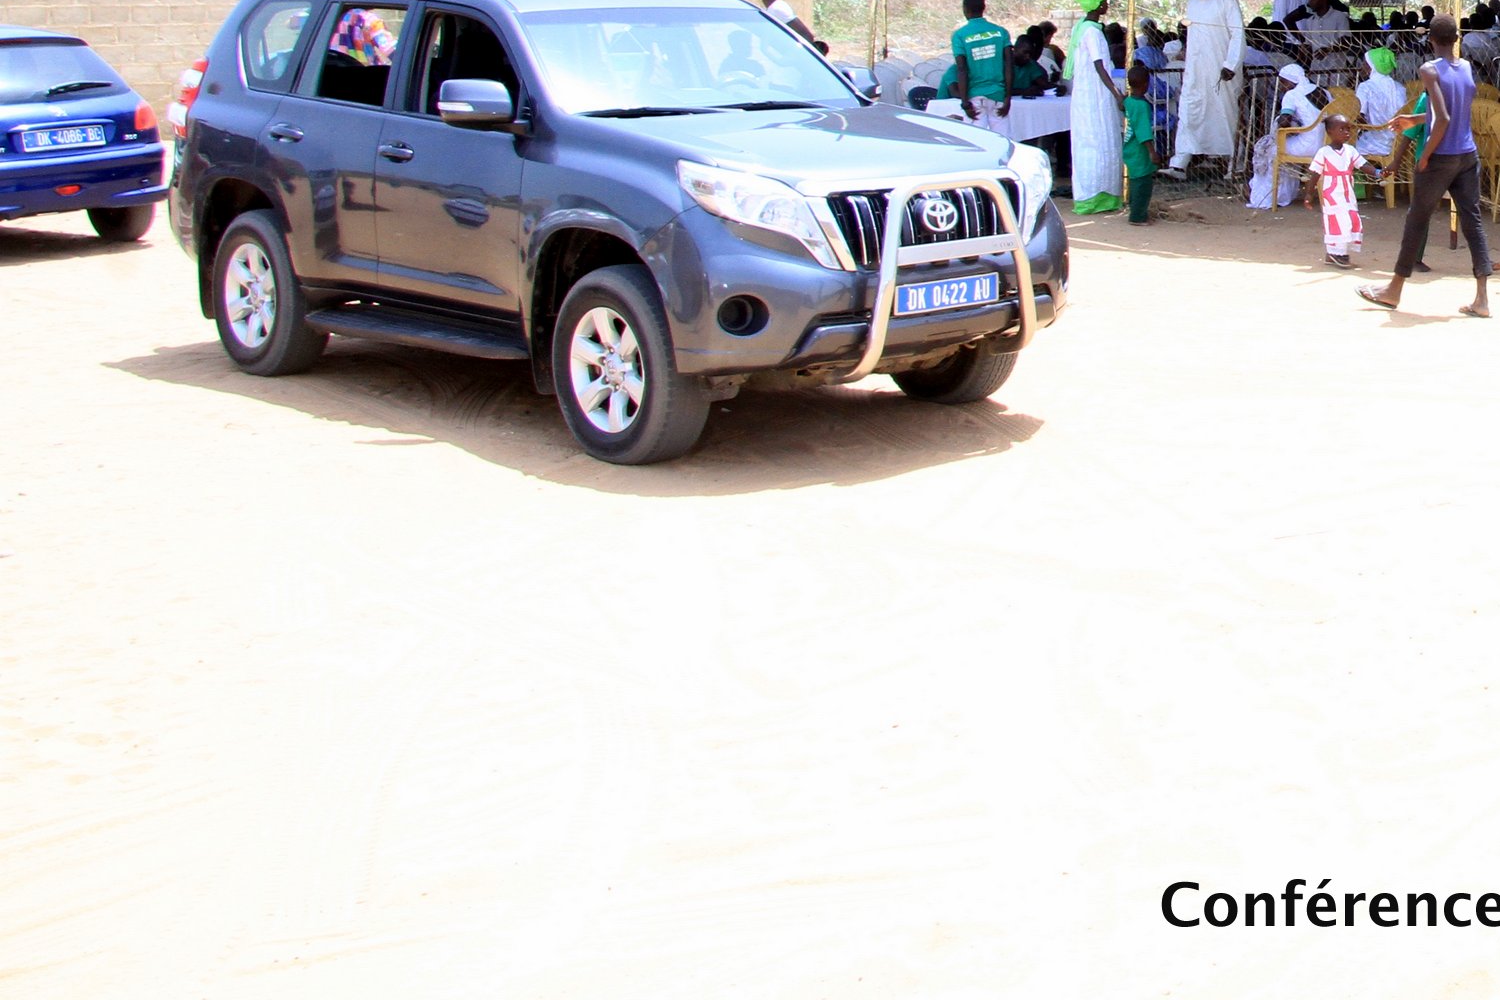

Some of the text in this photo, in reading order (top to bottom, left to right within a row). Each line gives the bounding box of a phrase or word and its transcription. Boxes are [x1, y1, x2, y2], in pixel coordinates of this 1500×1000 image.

[908, 277, 991, 311] DK 0422 AU
